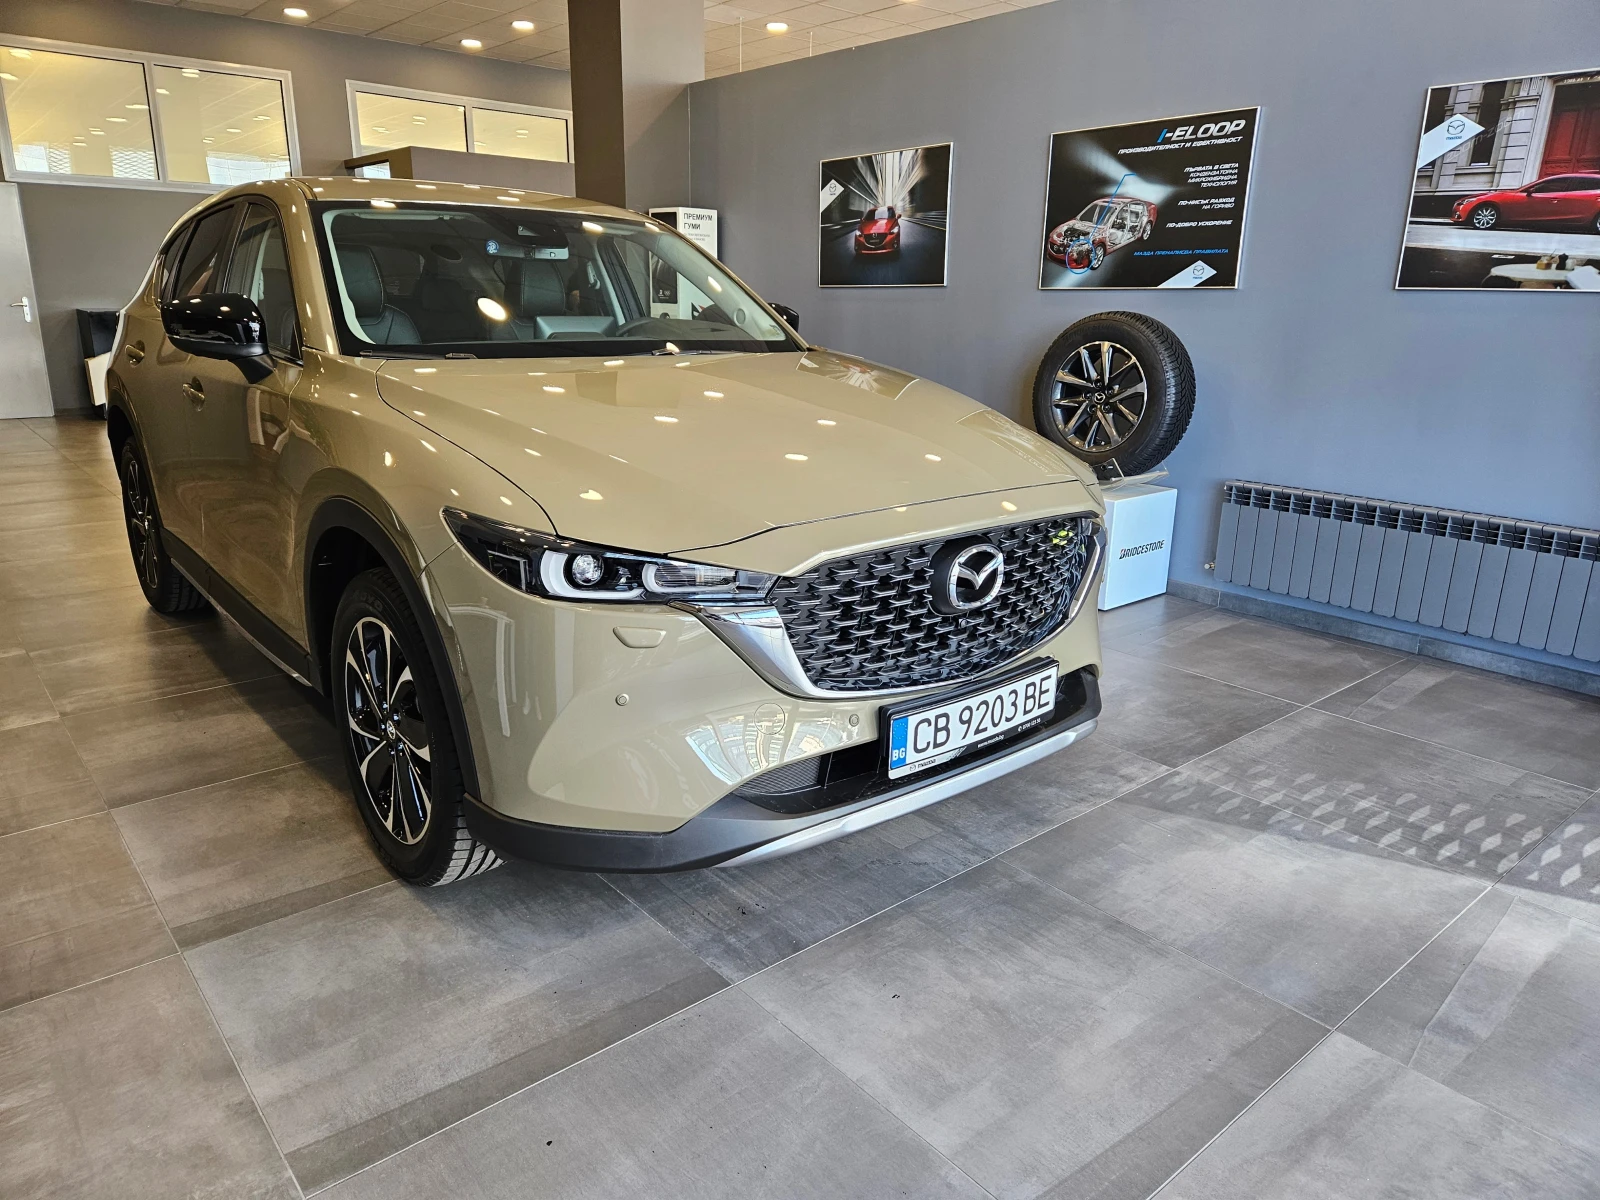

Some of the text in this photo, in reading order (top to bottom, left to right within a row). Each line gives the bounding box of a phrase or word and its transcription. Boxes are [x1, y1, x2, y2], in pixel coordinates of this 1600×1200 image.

[1118, 142, 1185, 154] ПРОИЗВОДИТЕЛНОСТ
[1192, 136, 1243, 147] ЕФЕКТИВНОСТ
[683, 212, 713, 221] ПРЕМИУМ
[683, 222, 701, 230] ГУМИ
[1119, 539, 1165, 560] BRIDGESTONE
[913, 674, 1052, 754] CB 9203 BE
[892, 747, 906, 761] BG
[917, 759, 937, 769] mazda
